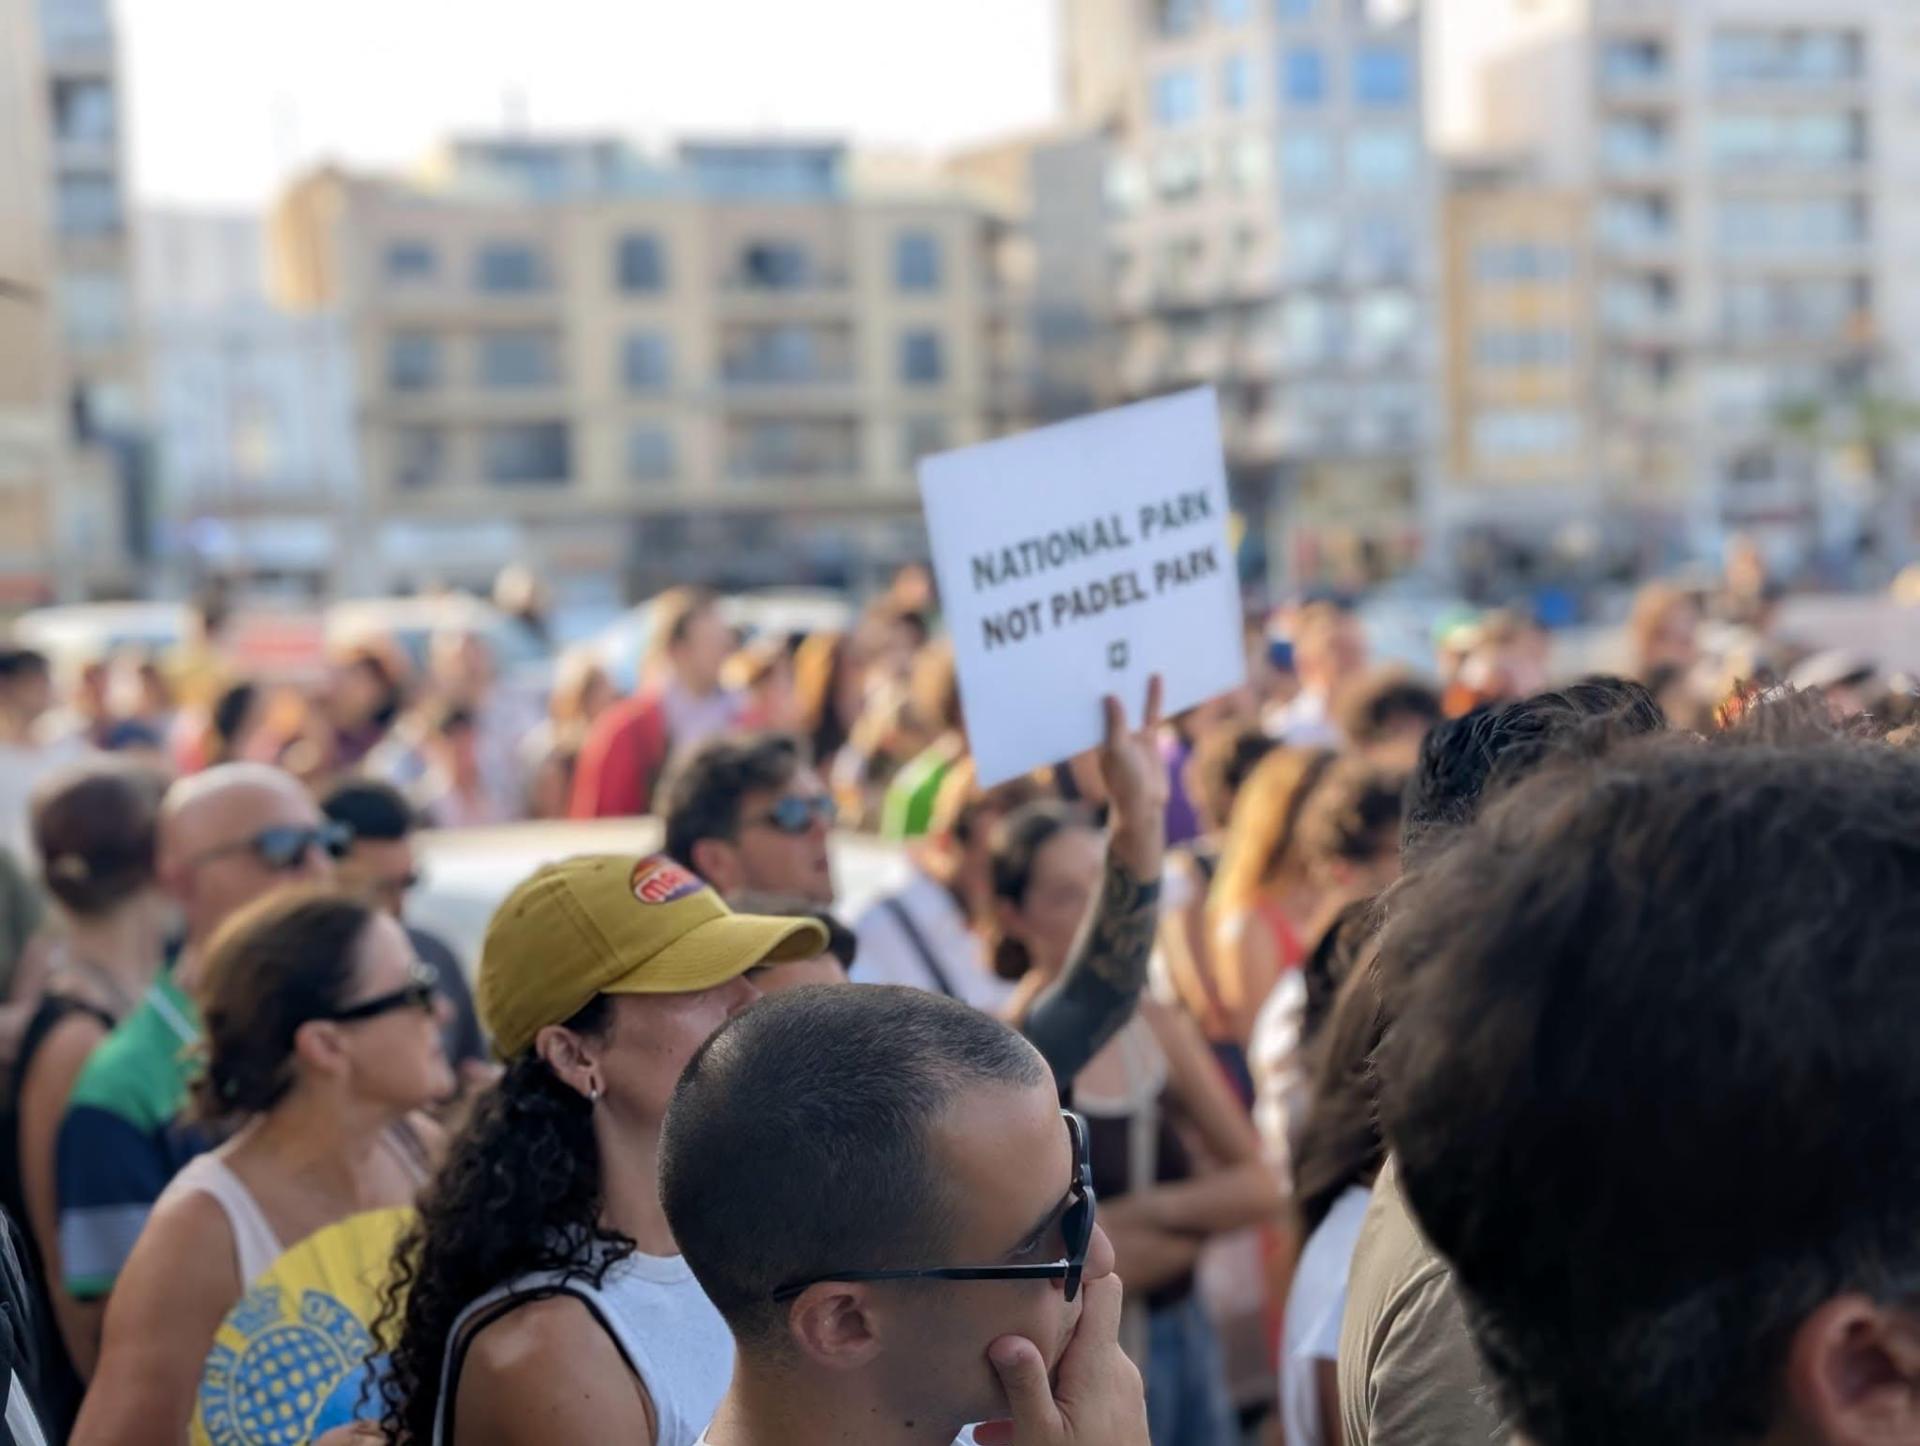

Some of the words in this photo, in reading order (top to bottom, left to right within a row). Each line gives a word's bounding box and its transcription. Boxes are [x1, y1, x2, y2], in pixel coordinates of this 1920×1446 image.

[970, 515, 1131, 591] NATIONAL
[1139, 490, 1212, 538] PARK
[981, 600, 1042, 650] NOT
[1050, 571, 1148, 627] PADEL
[1154, 546, 1218, 592] PARK
